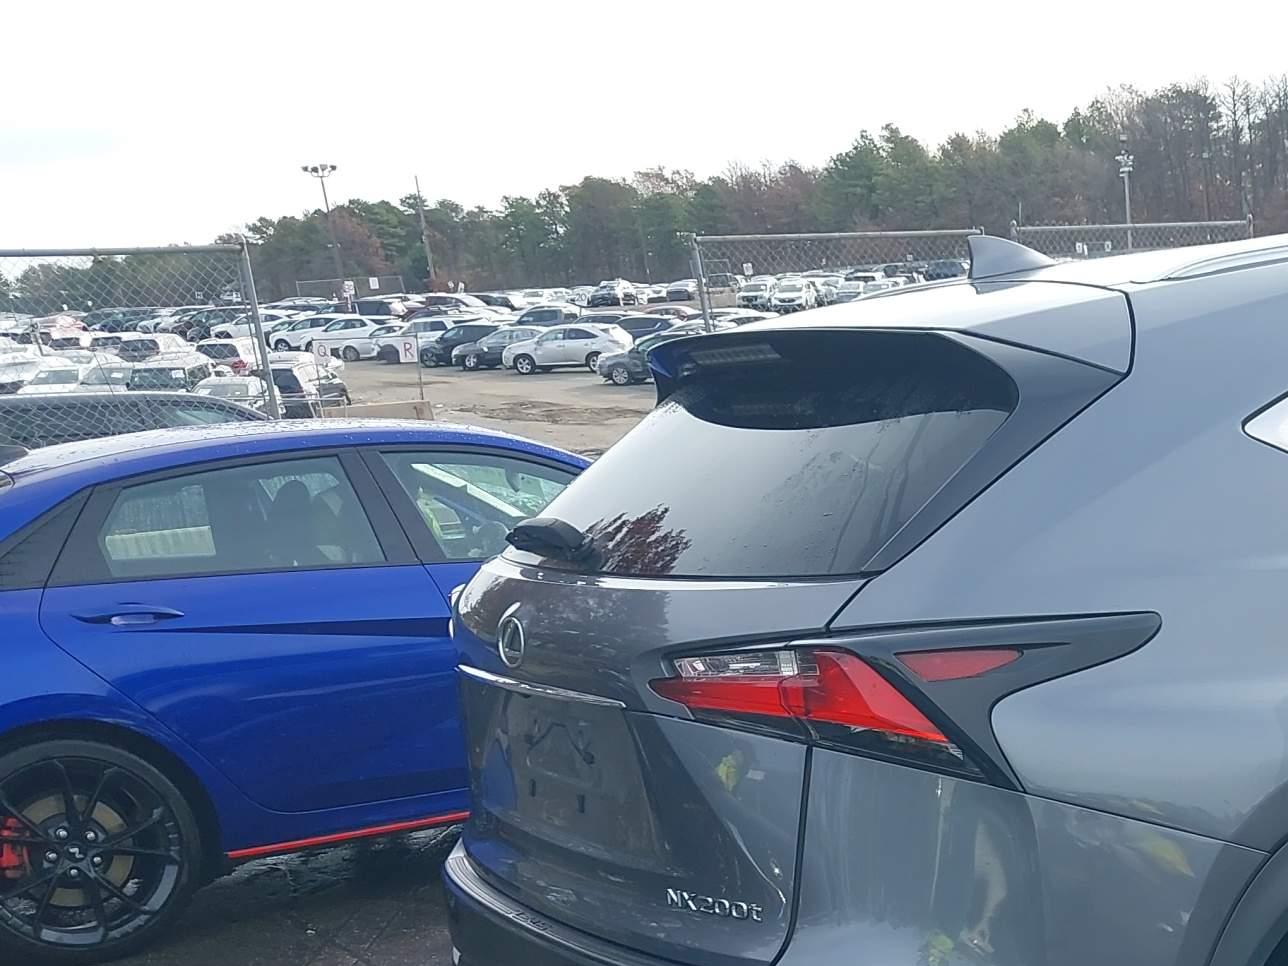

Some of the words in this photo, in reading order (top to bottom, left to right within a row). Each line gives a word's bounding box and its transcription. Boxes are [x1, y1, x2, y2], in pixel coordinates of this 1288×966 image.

[317, 345, 329, 357] Q
[403, 342, 414, 358] R
[666, 888, 762, 921] NX200t
